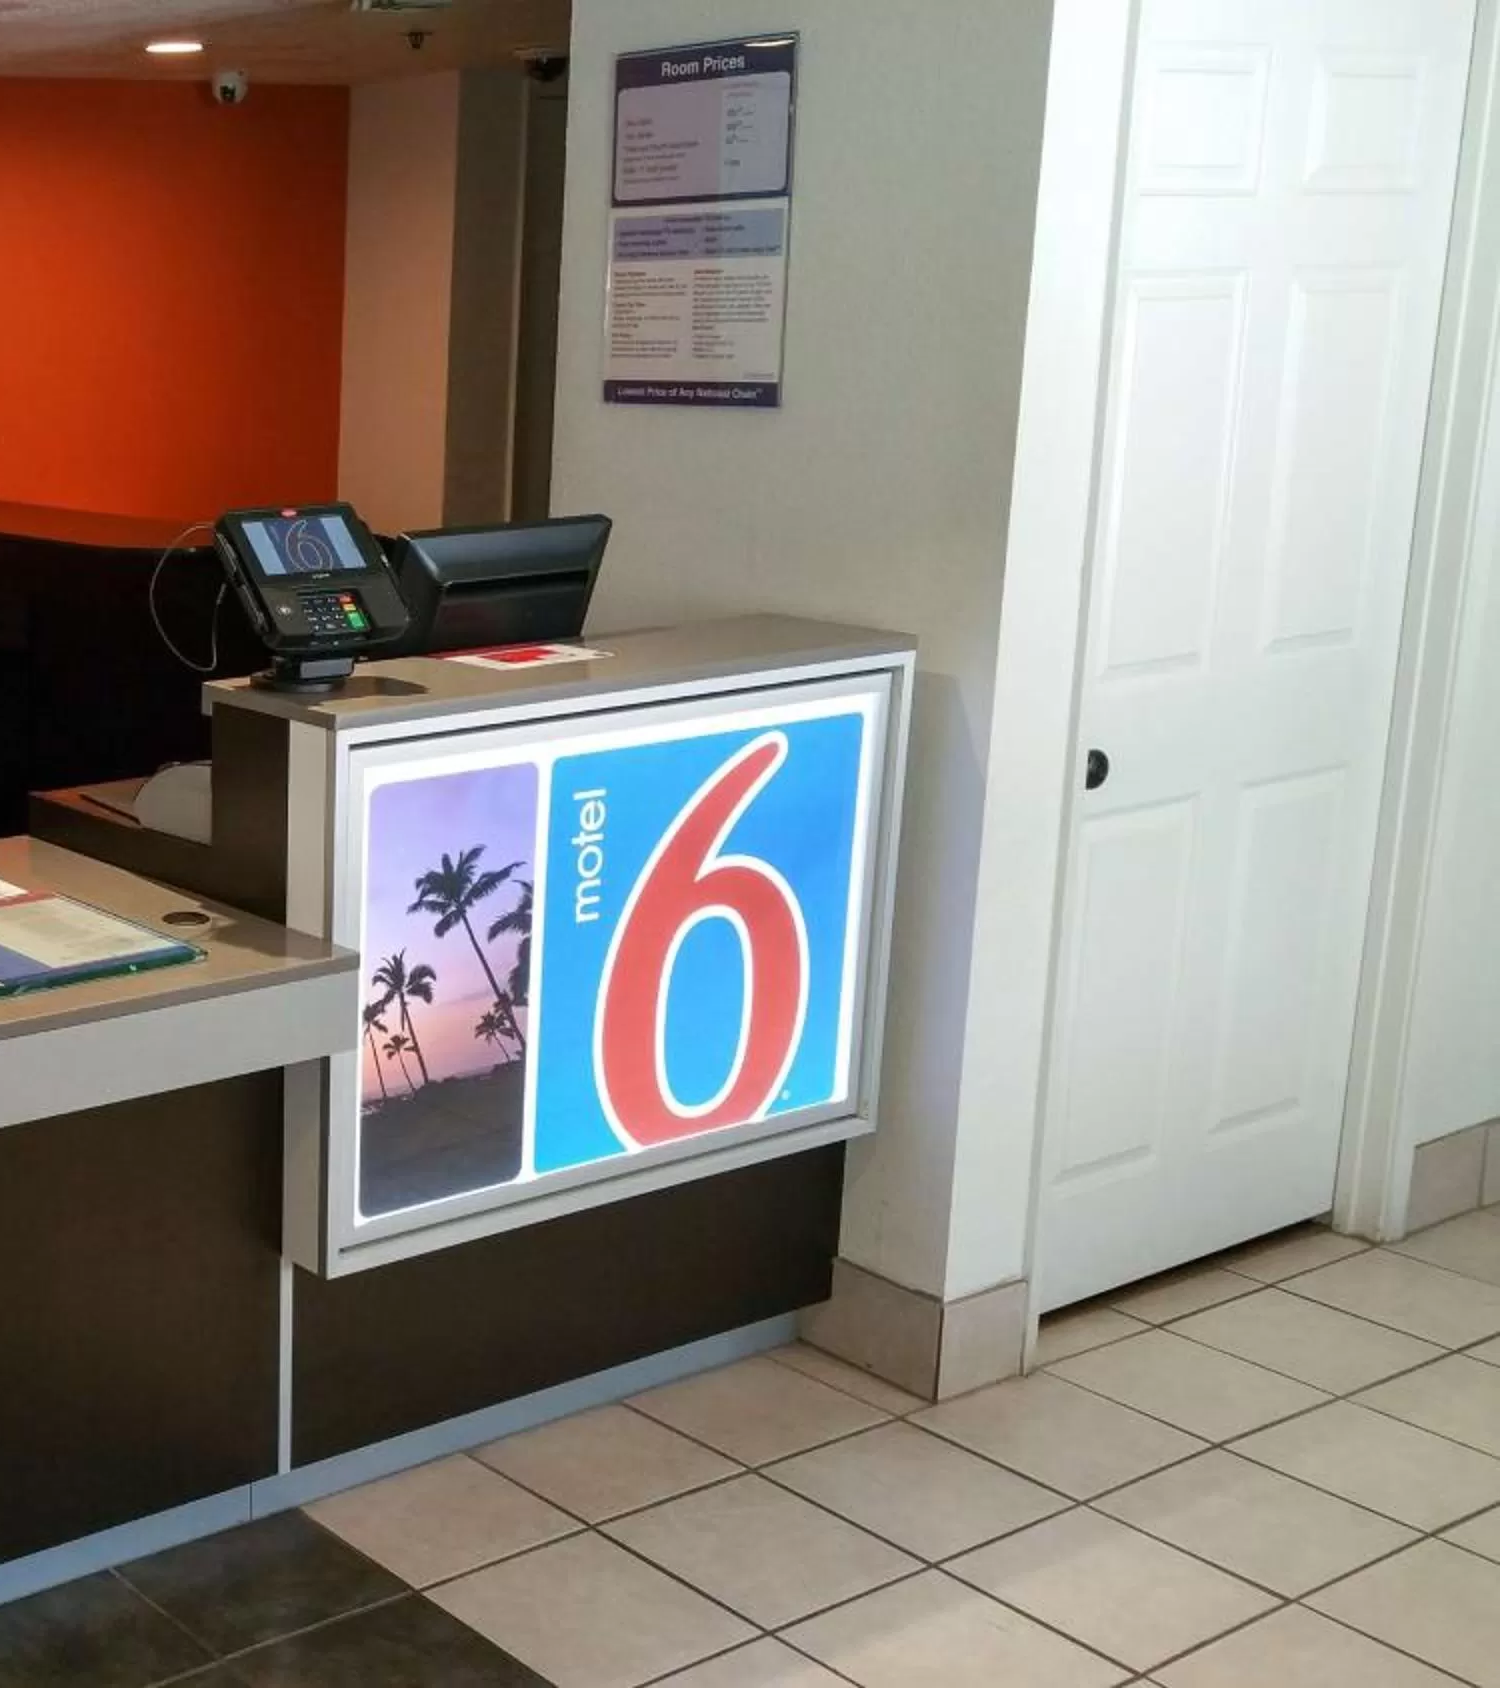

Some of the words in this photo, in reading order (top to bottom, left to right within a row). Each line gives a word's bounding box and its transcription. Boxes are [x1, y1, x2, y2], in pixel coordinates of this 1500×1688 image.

[661, 60, 699, 77] Room
[703, 55, 746, 71] Prices
[571, 788, 607, 924] motel
[592, 730, 810, 1153] 6
